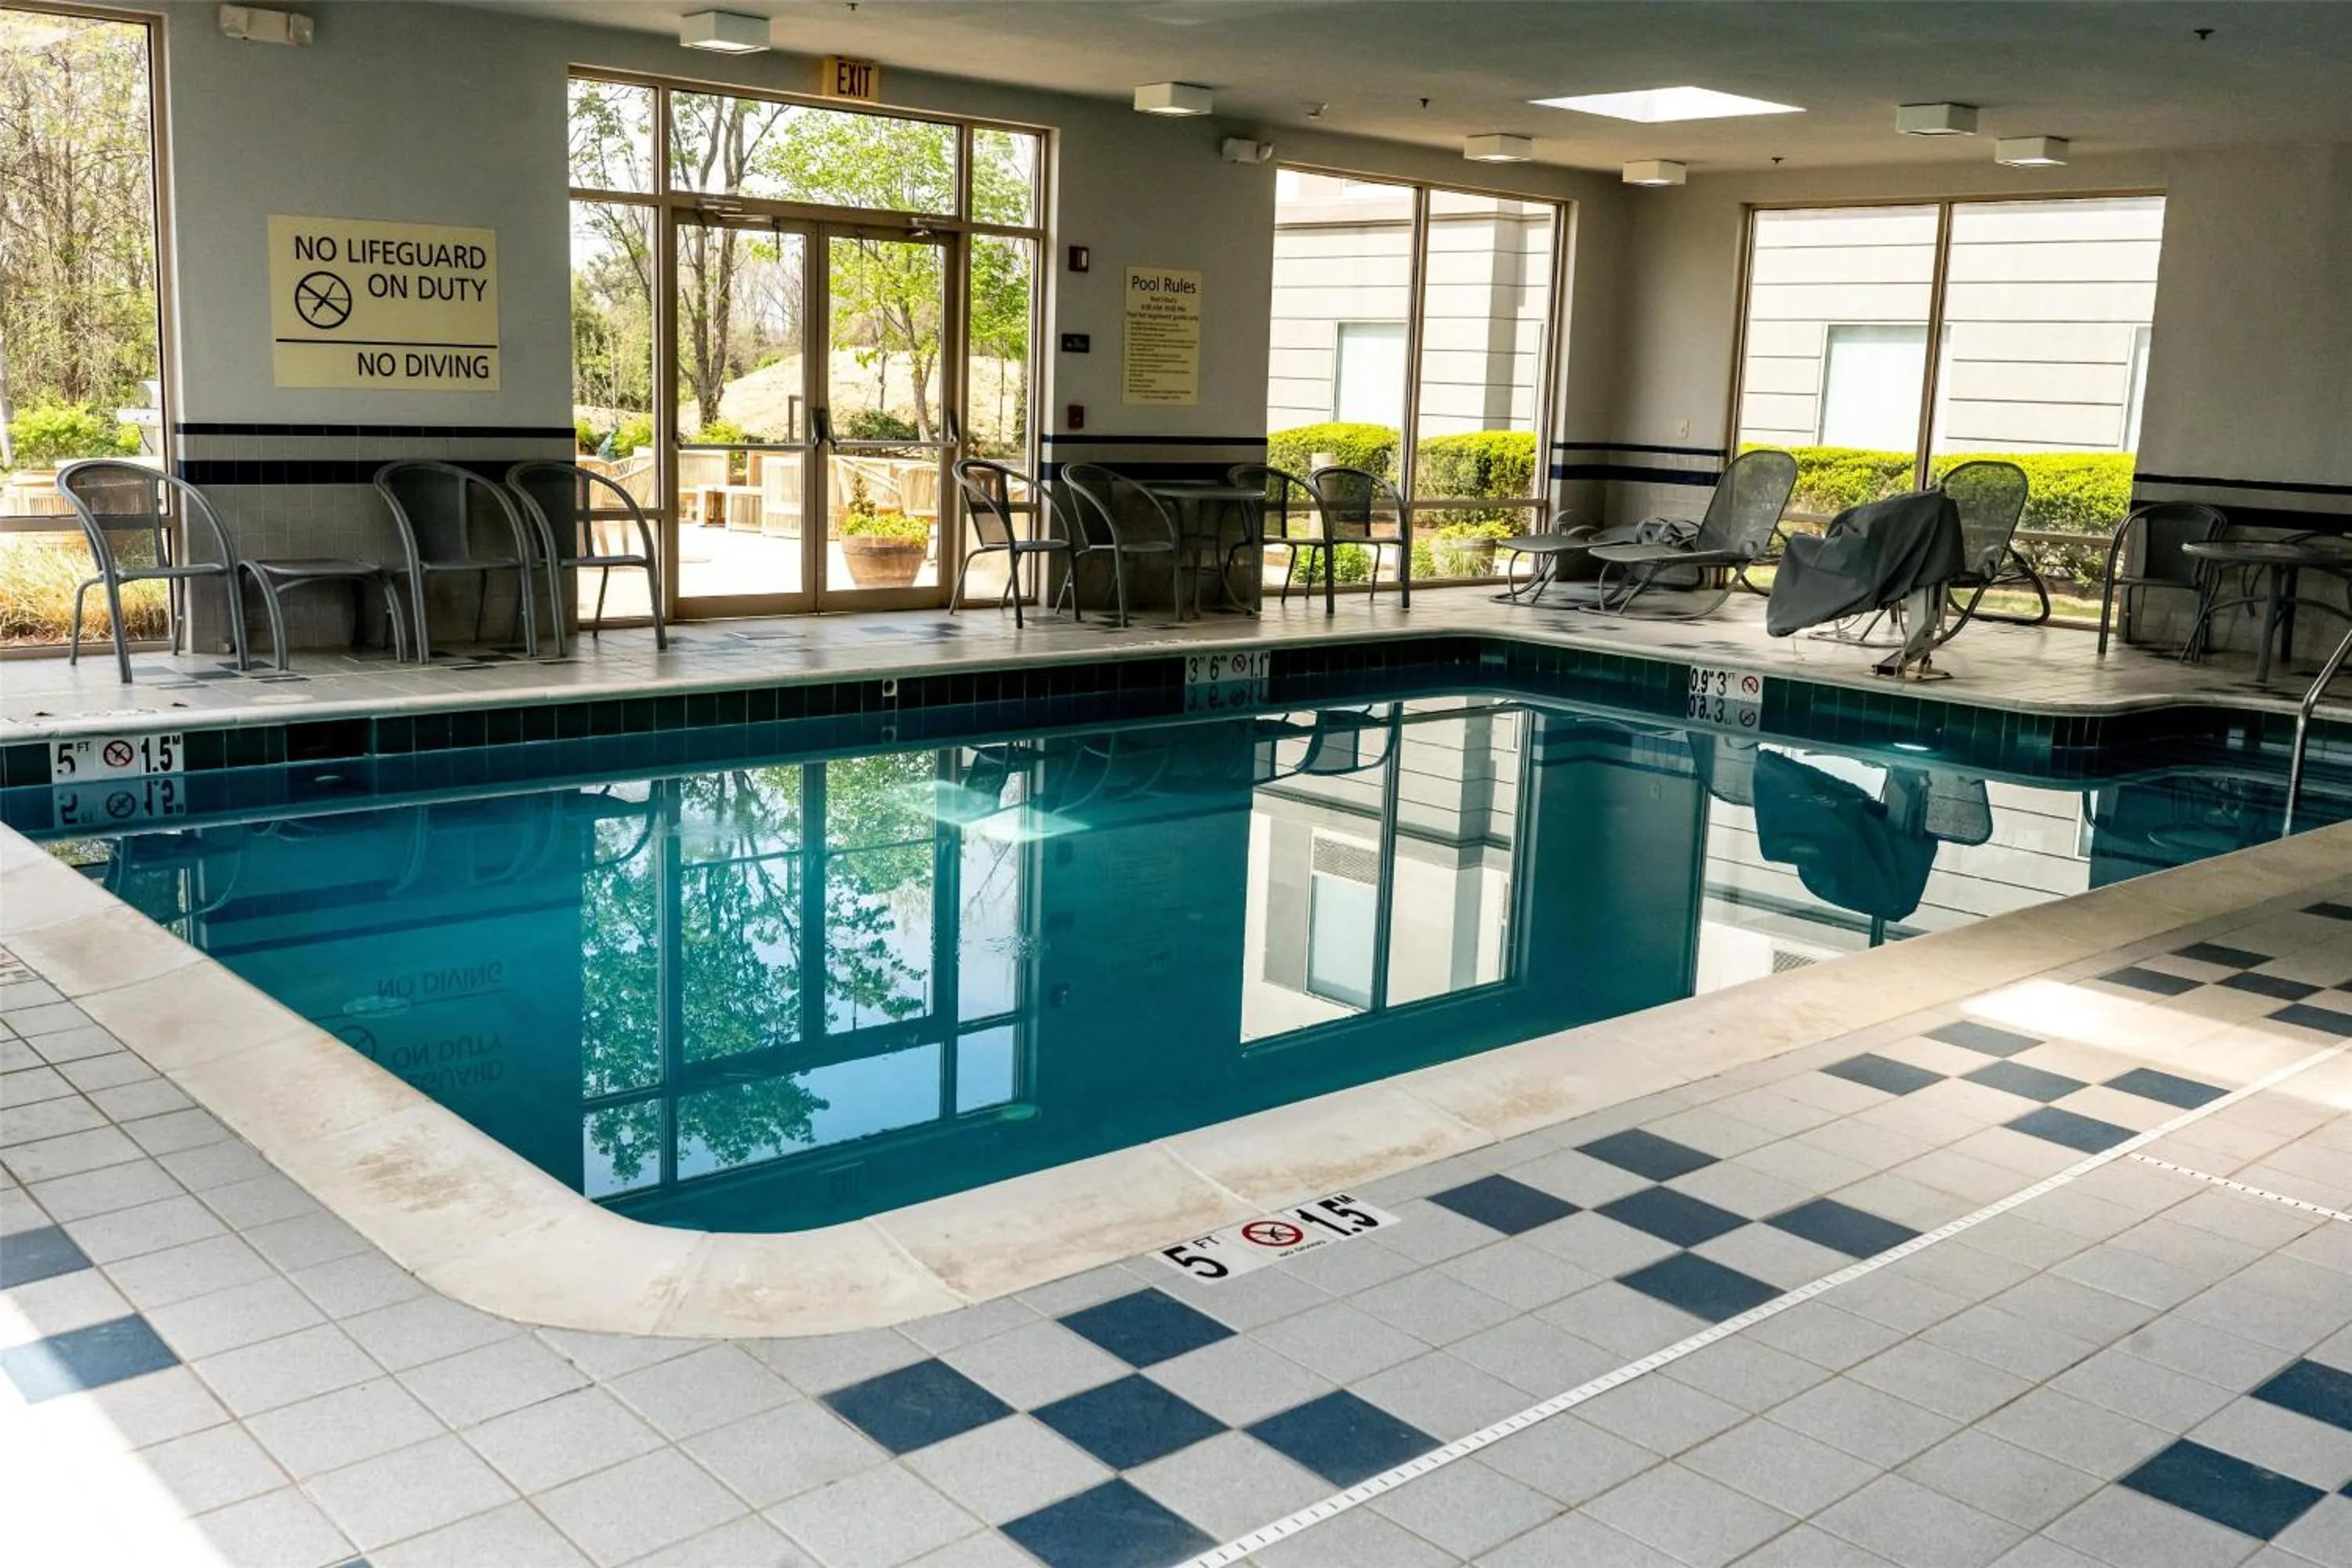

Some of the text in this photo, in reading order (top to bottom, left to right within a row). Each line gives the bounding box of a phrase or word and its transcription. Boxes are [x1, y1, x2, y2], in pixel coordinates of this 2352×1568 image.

[837, 62, 873, 97] EXIT
[295, 235, 486, 269] NO LIFEGUARD
[368, 273, 487, 302] ON DUTY
[1131, 275, 1196, 294] Pool Rules
[358, 352, 488, 379] NO DIVING
[1189, 657, 1199, 682] 3
[1210, 655, 1219, 681] 6
[1717, 671, 1726, 696] 3
[56, 742, 90, 775] 5 FT
[141, 735, 172, 773] 1.5
[1295, 1199, 1379, 1236] 1.5
[1161, 1236, 1229, 1279] 5 FT
